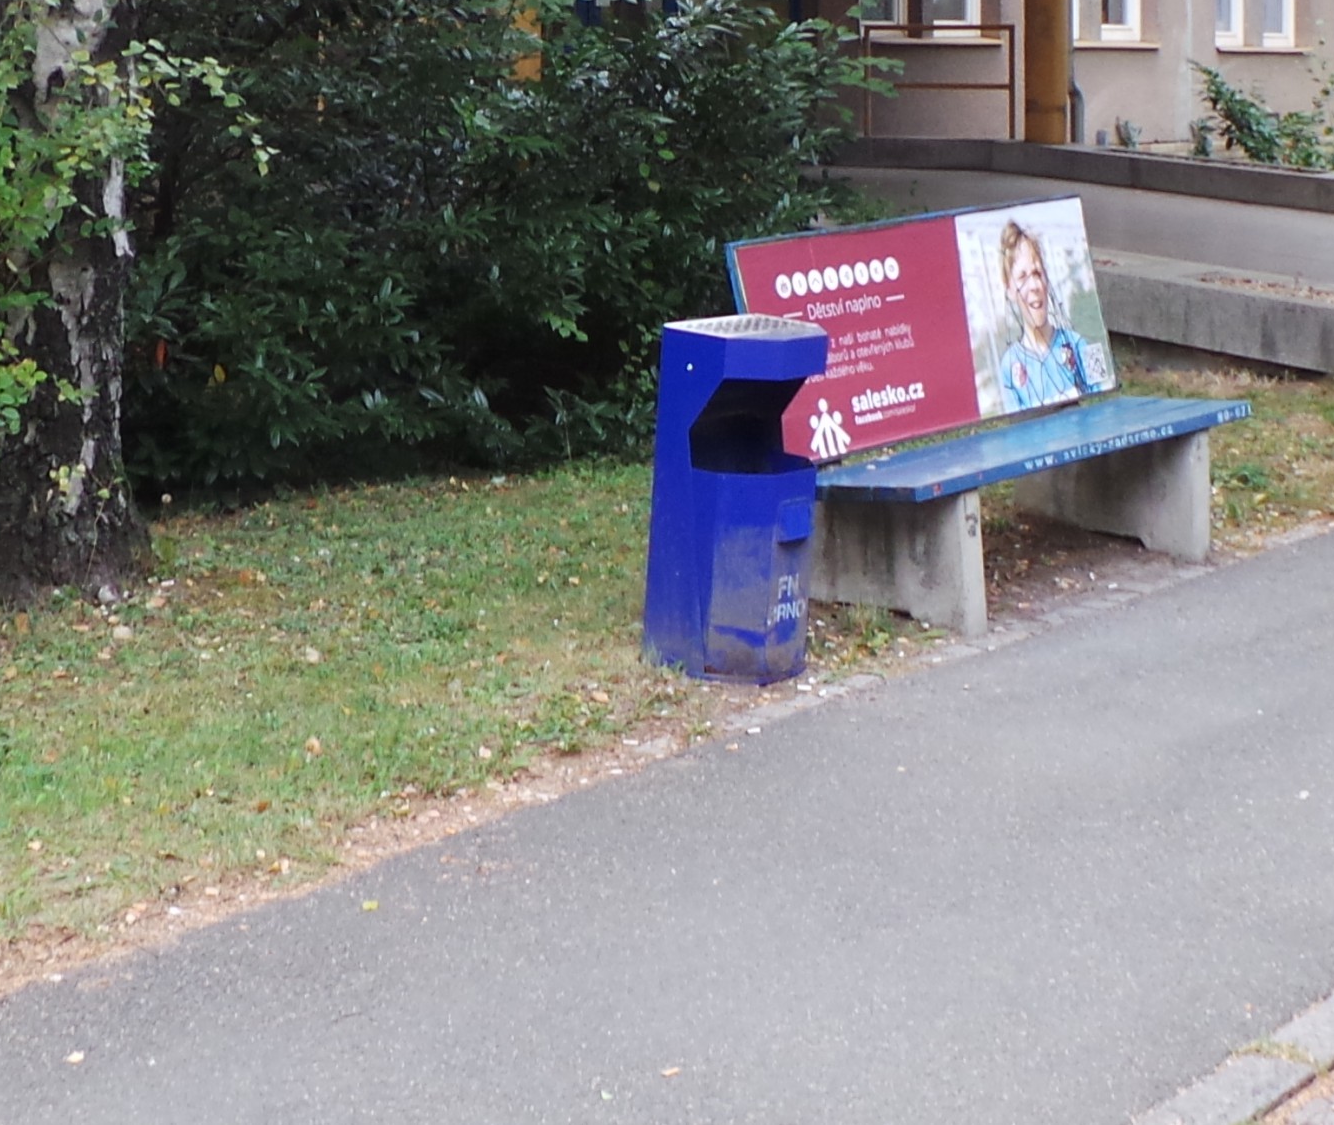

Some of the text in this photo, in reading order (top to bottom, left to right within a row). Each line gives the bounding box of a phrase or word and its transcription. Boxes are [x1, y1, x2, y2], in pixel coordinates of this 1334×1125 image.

[807, 294, 881, 320] Dětství naplno
[851, 382, 925, 413] salesko.cz
[778, 573, 800, 599] FN
